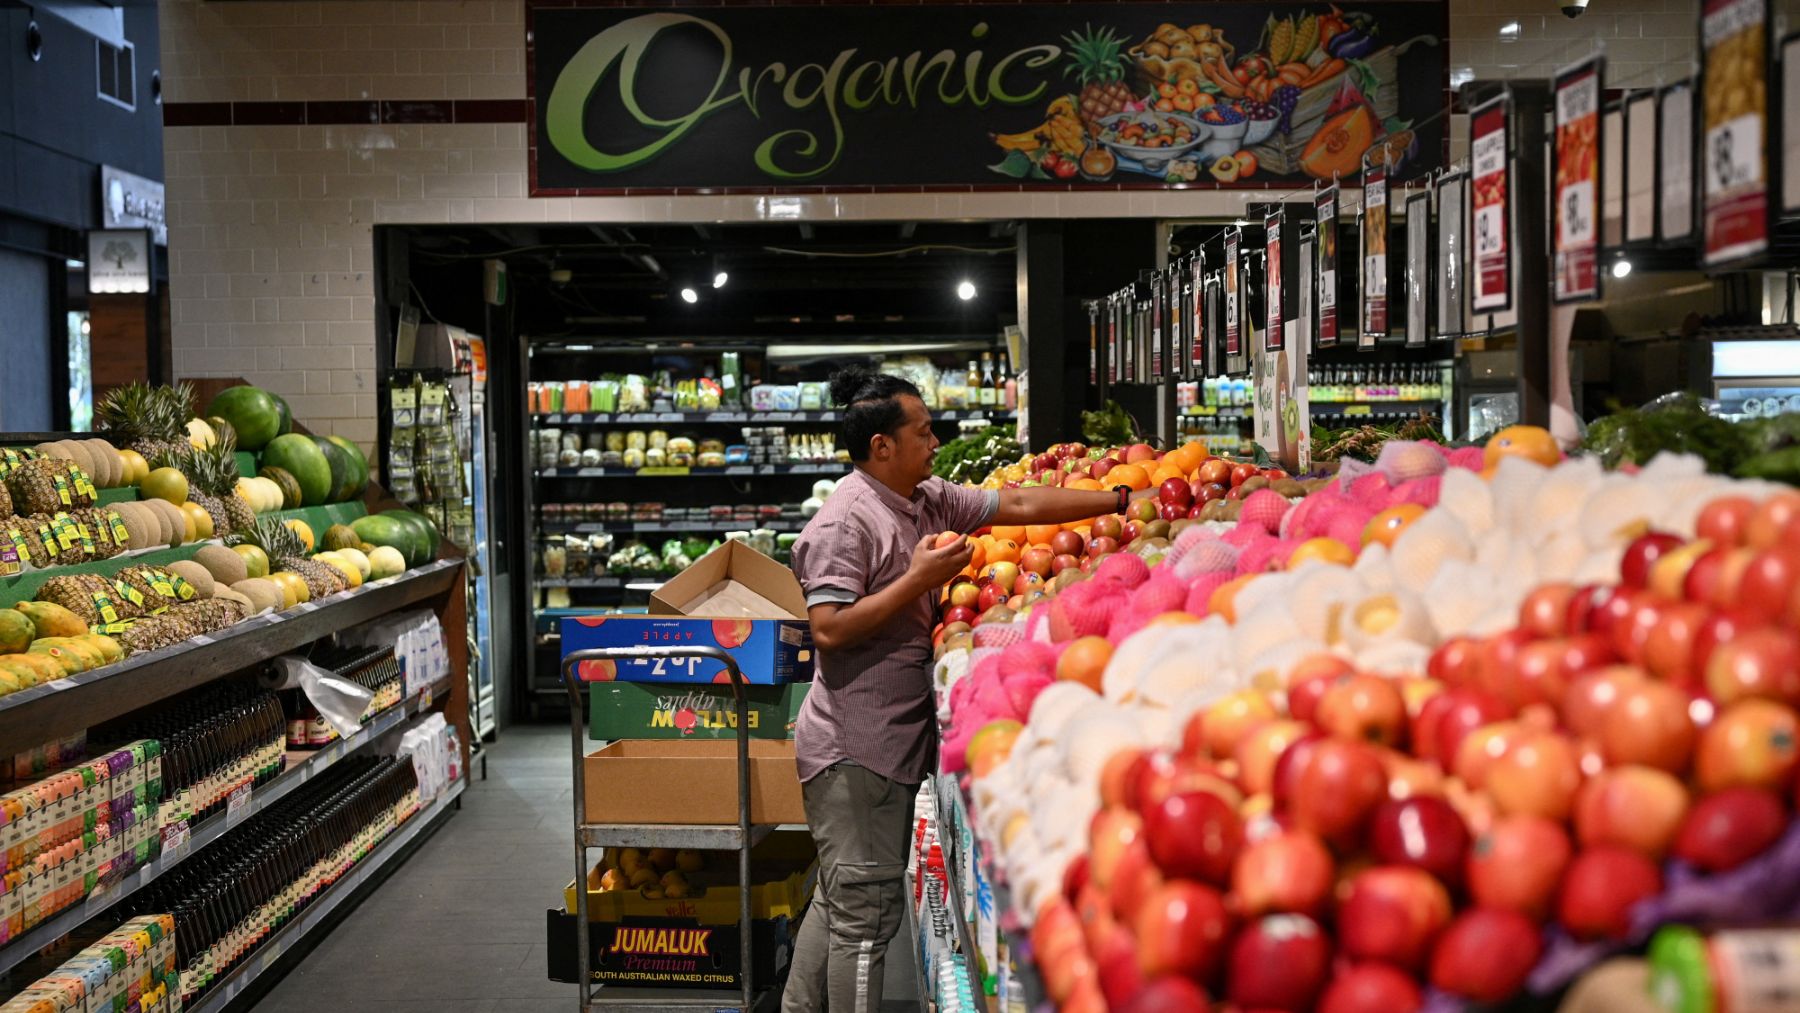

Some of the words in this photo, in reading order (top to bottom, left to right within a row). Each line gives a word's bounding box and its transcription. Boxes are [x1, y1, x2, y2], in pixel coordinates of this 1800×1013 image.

[546, 12, 1061, 178] Organic
[642, 631, 693, 641] APPLE
[654, 690, 715, 718] apples
[611, 927, 713, 956] JUMALUK
[624, 955, 697, 972] Premium
[618, 971, 671, 981] AUSTRALIAN
[671, 973, 702, 983] WAXED
[703, 973, 734, 983] CITRUS
